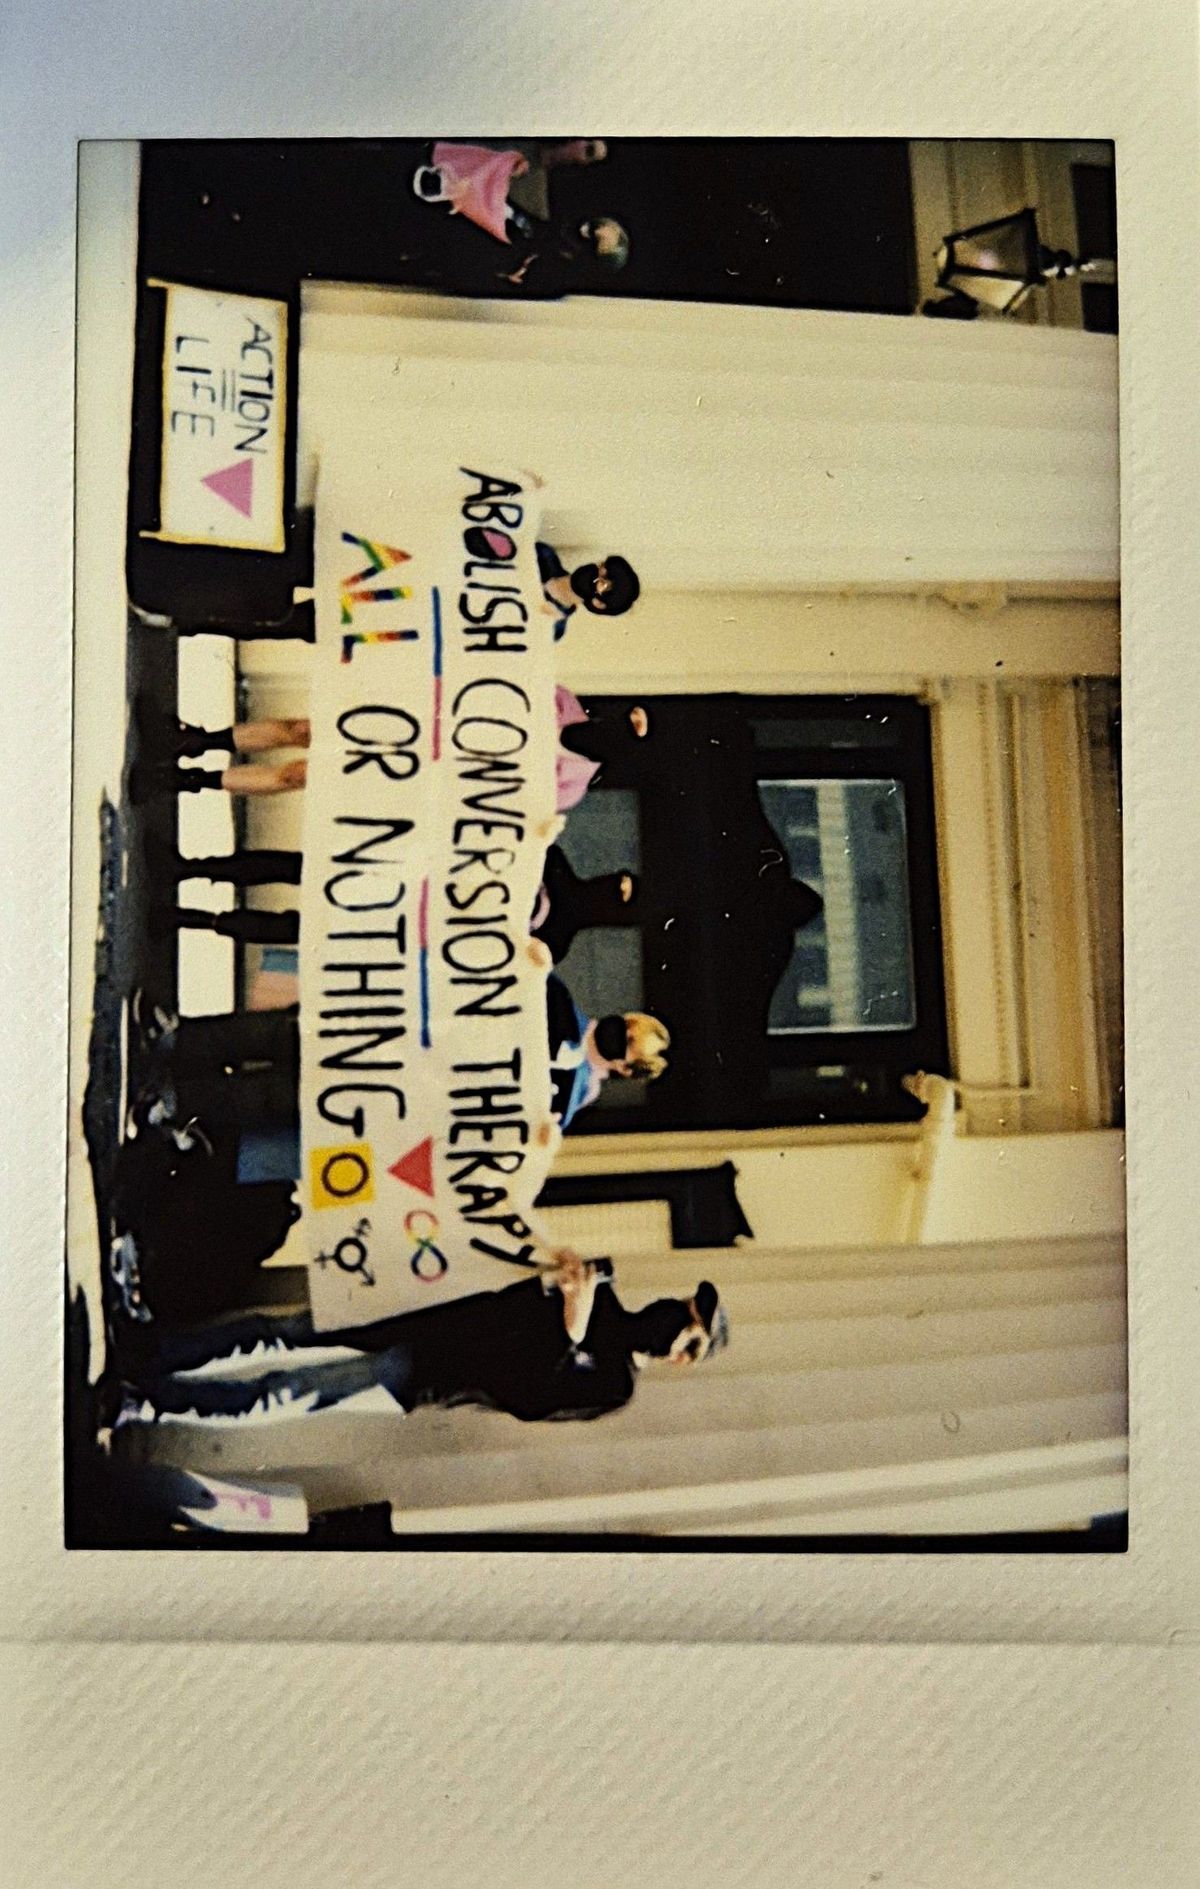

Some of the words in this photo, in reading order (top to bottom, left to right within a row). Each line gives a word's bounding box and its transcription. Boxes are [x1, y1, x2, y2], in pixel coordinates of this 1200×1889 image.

[170, 335, 216, 438] LIFE
[233, 314, 274, 455] ACTION
[339, 531, 420, 665] ALL
[458, 466, 529, 653] ABOLISH
[335, 704, 421, 781] OR
[442, 678, 531, 1017] CONVERSION
[317, 817, 415, 1138] NOTHING
[444, 1047, 545, 1269] THERAPY
